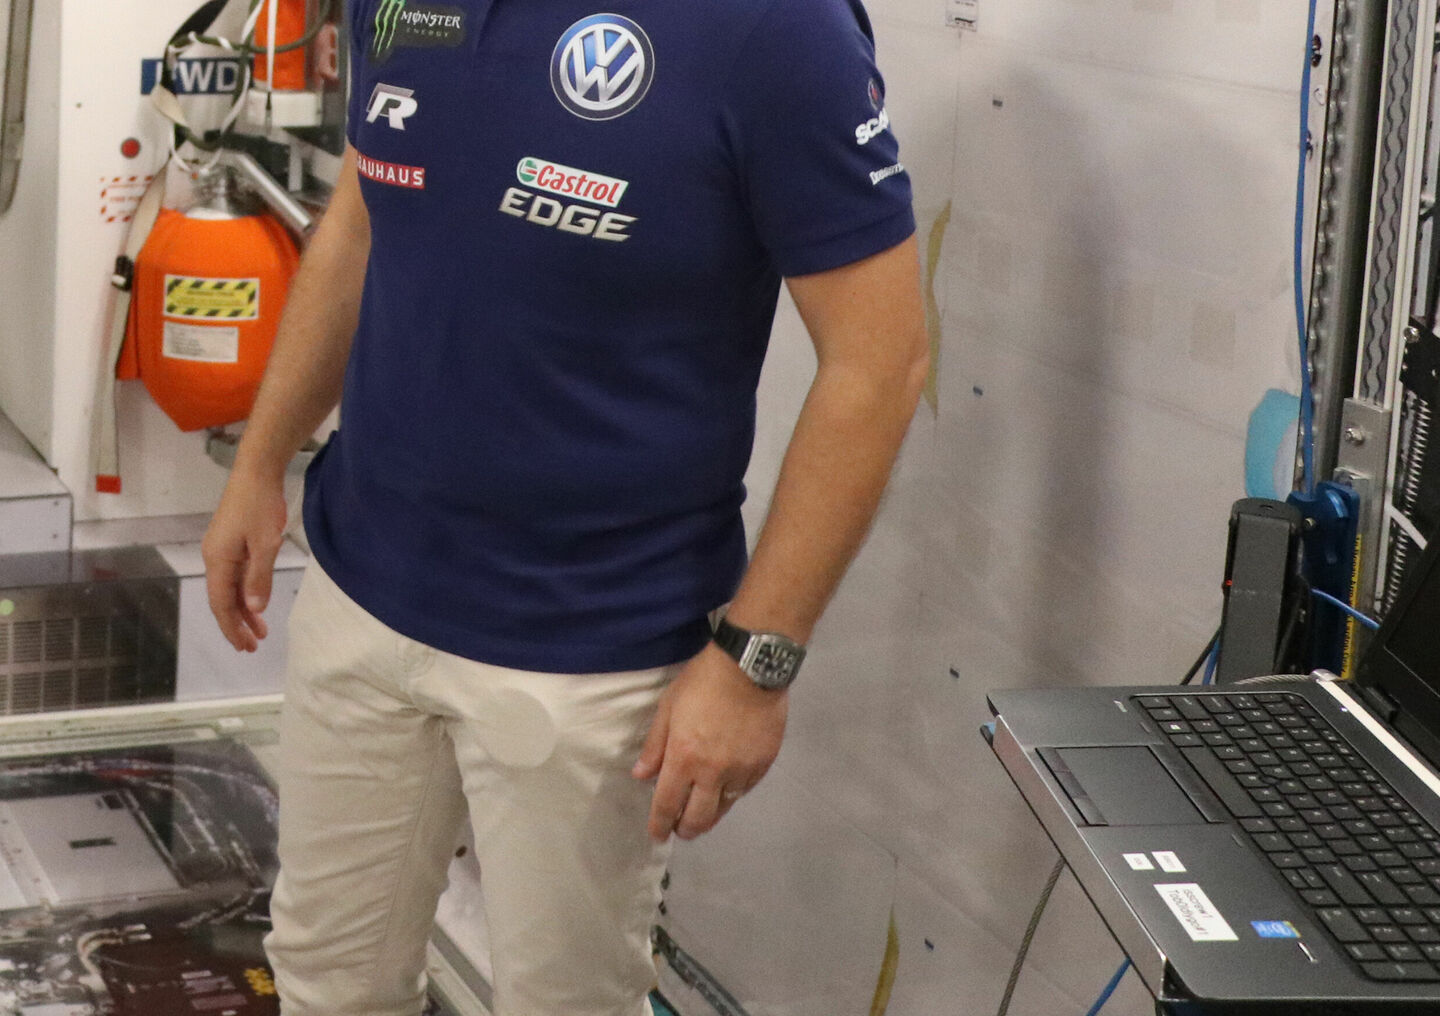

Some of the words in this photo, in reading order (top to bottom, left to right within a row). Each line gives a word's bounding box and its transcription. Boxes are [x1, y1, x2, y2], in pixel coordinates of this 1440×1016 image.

[400, 10, 461, 29] MONSTER
[366, 83, 418, 131] R
[536, 165, 621, 204] Castrol
[499, 187, 640, 242] EDGE
